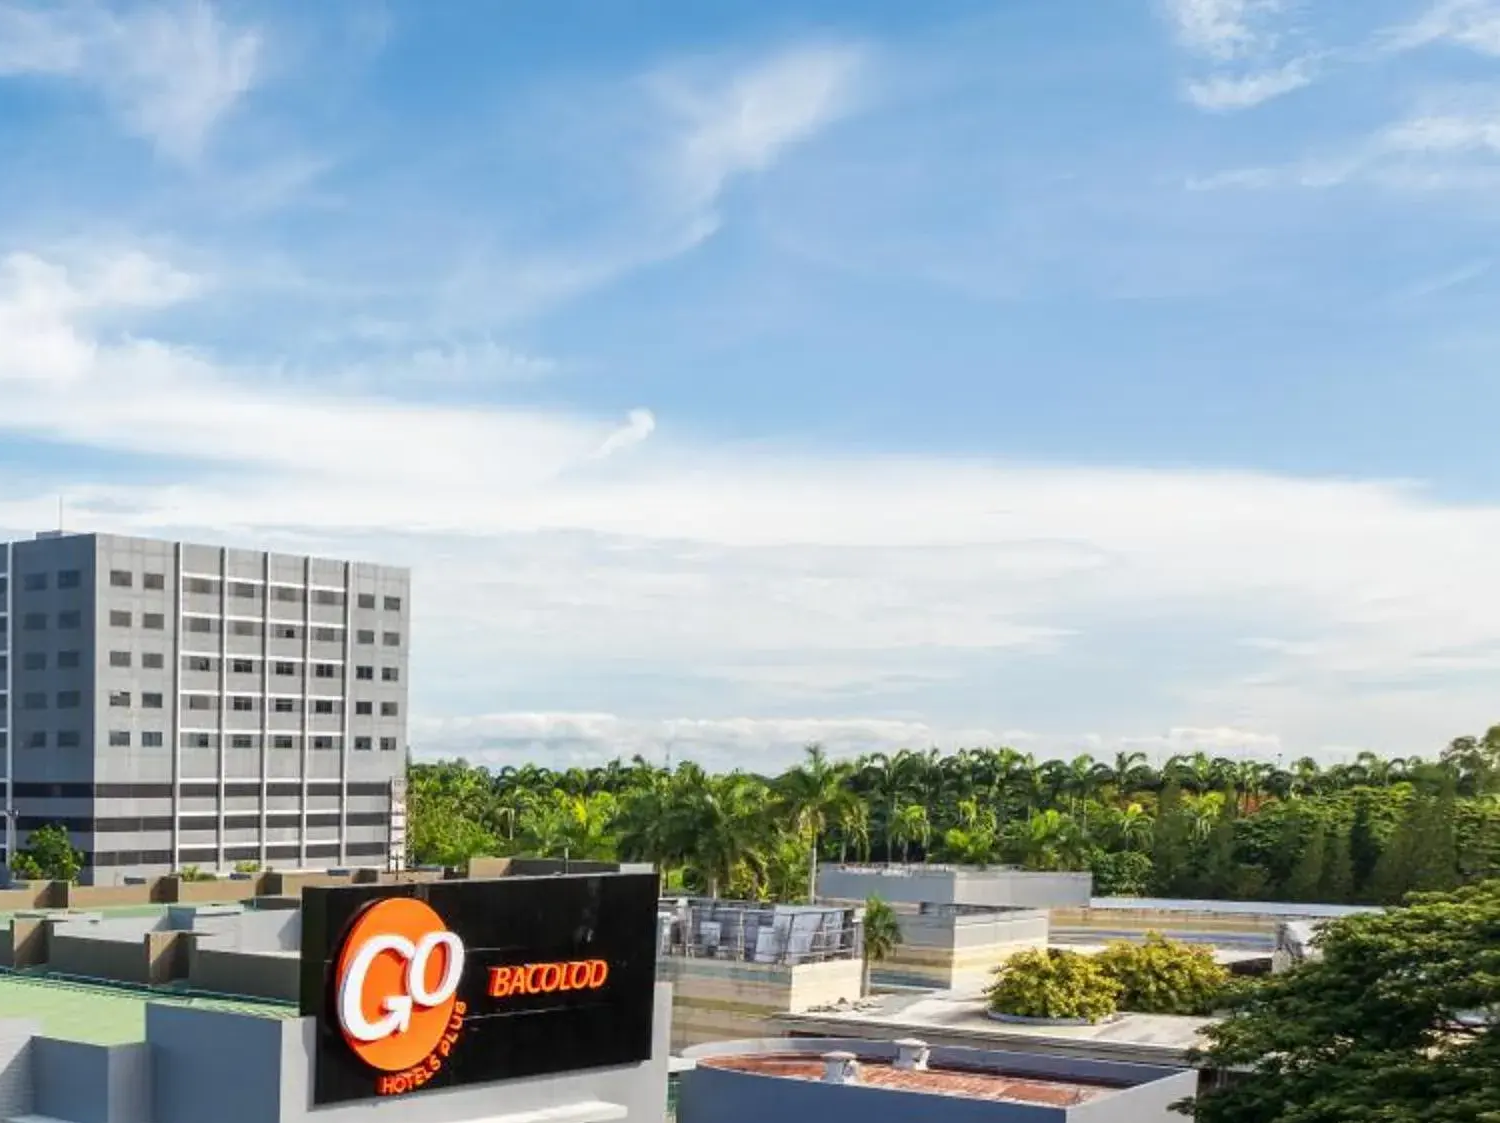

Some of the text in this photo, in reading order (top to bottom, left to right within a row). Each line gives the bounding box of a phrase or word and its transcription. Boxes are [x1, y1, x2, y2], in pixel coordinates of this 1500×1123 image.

[488, 958, 608, 997] BACOLOD
[380, 1001, 467, 1094] HOTELS PLUS
